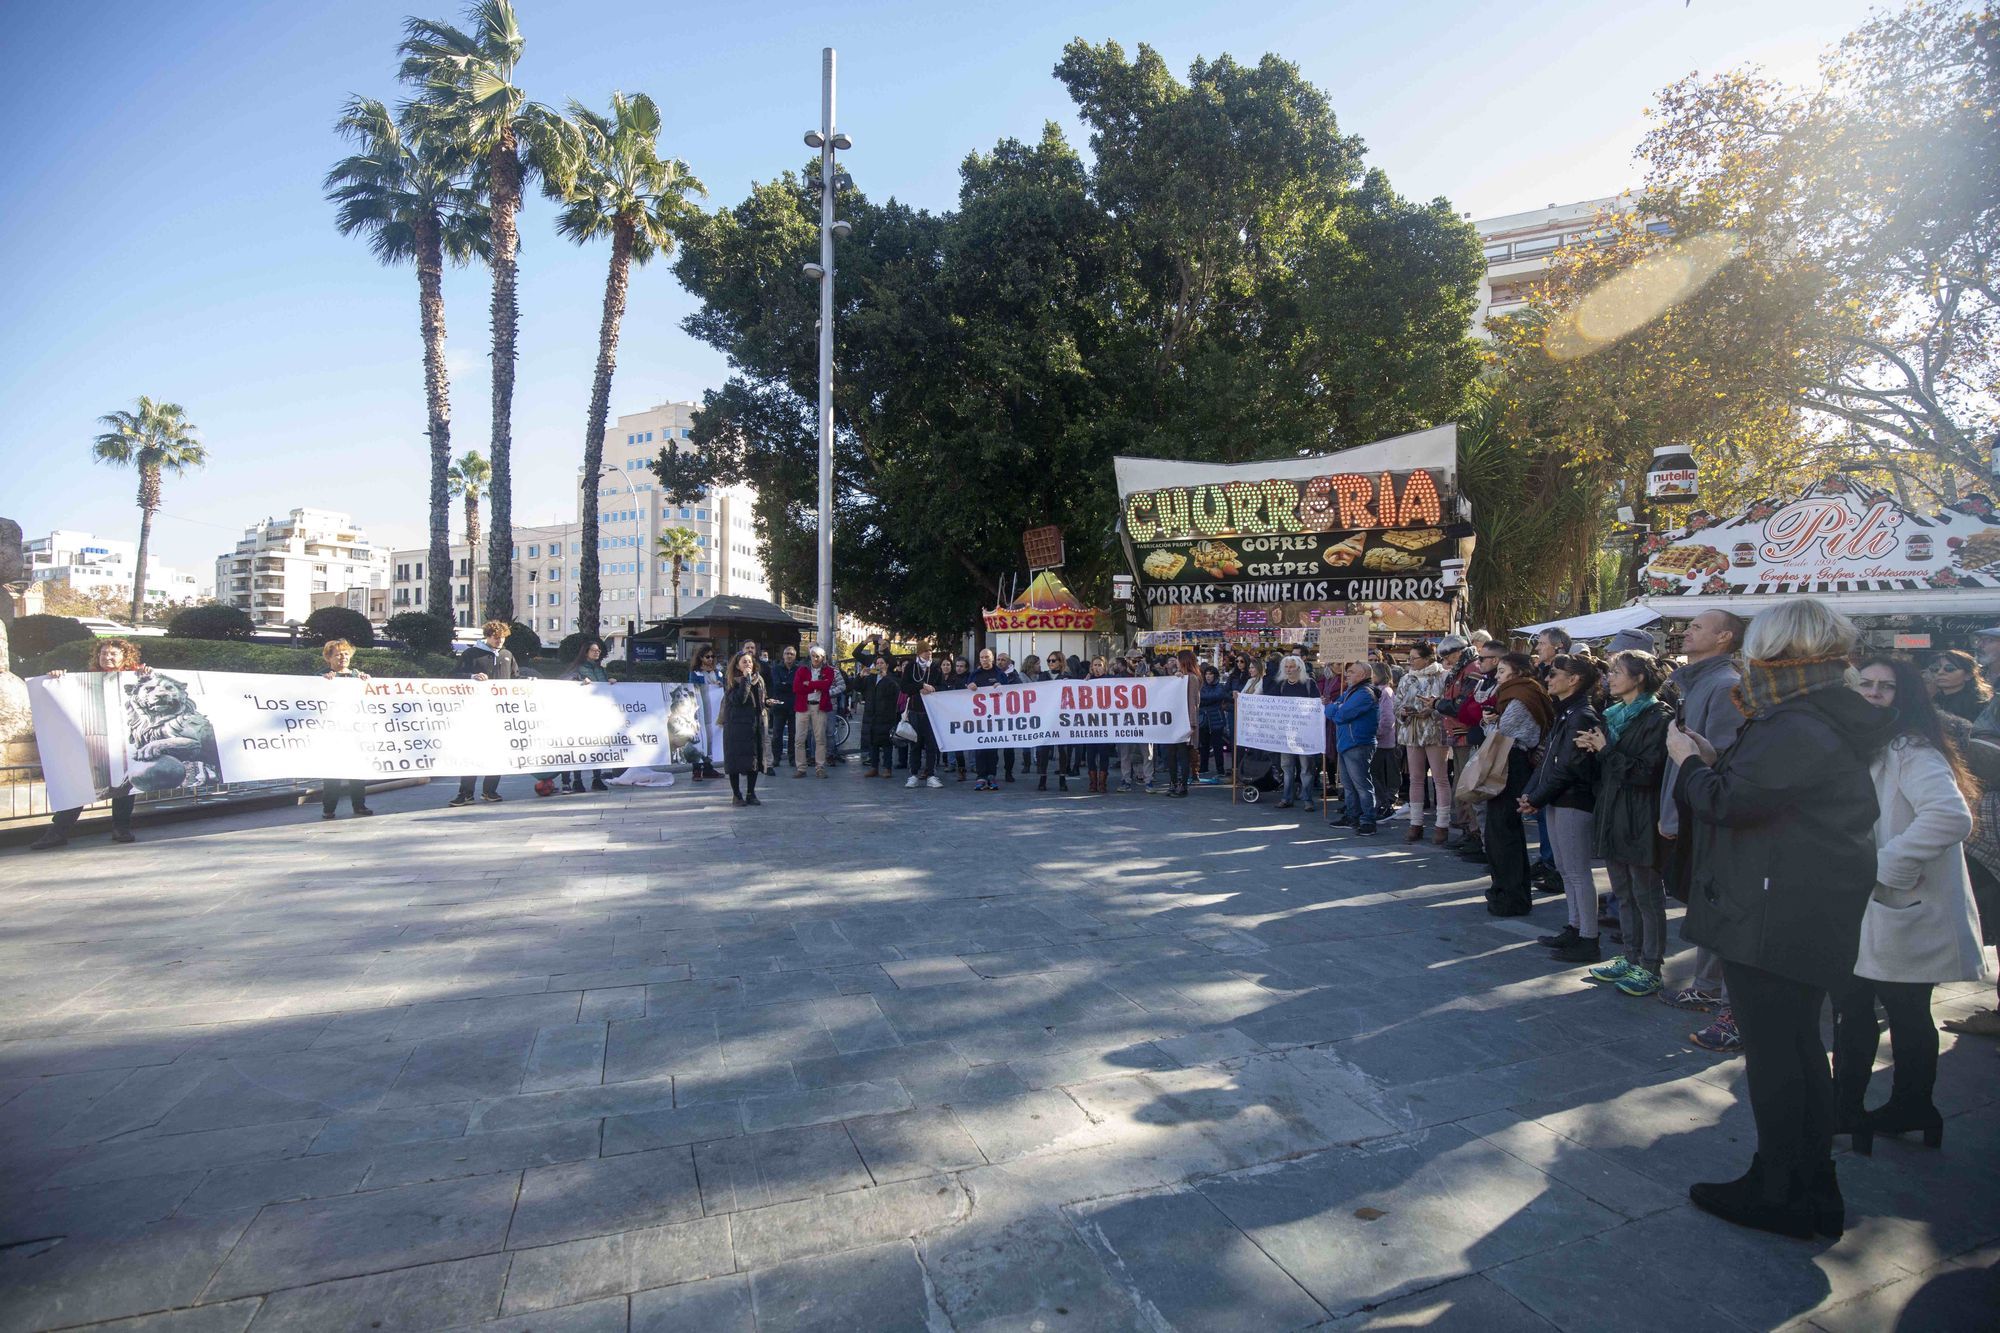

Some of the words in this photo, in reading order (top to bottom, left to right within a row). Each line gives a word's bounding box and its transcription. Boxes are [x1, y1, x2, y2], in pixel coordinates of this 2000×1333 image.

[1653, 470, 1695, 482] nutella
[1126, 468, 1441, 543] CHURRERIA
[1764, 502, 1898, 558] Pili
[1172, 541, 1193, 549] PROPIA
[1241, 536, 1318, 551] GOFRES
[1247, 562, 1319, 577] CREPES
[1760, 569, 1800, 584] Crepes
[1803, 574, 1811, 586] y
[1816, 566, 1856, 582] Gofres
[1859, 565, 1929, 579] Artesanos
[1147, 584, 1215, 605] PORRAS
[1347, 577, 1445, 601] CHURROS
[1026, 614, 1095, 629] CREPES
[364, 683, 390, 695] Art
[394, 682, 420, 695] 14.
[392, 701, 423, 714] son
[524, 699, 537, 713] la
[972, 689, 1037, 717] STOP
[1060, 684, 1147, 710] ABUSO
[949, 713, 1041, 735] POLÍTICO
[1059, 711, 1172, 727] SANITARIO
[977, 734, 1010, 744] CANAL
[1012, 730, 1060, 742] TELEGRAM
[1069, 729, 1109, 739] BALEARES
[1114, 726, 1144, 738] ACCIÓN
[399, 758, 411, 771] o
[517, 750, 576, 770] personal
[578, 752, 587, 763] o
